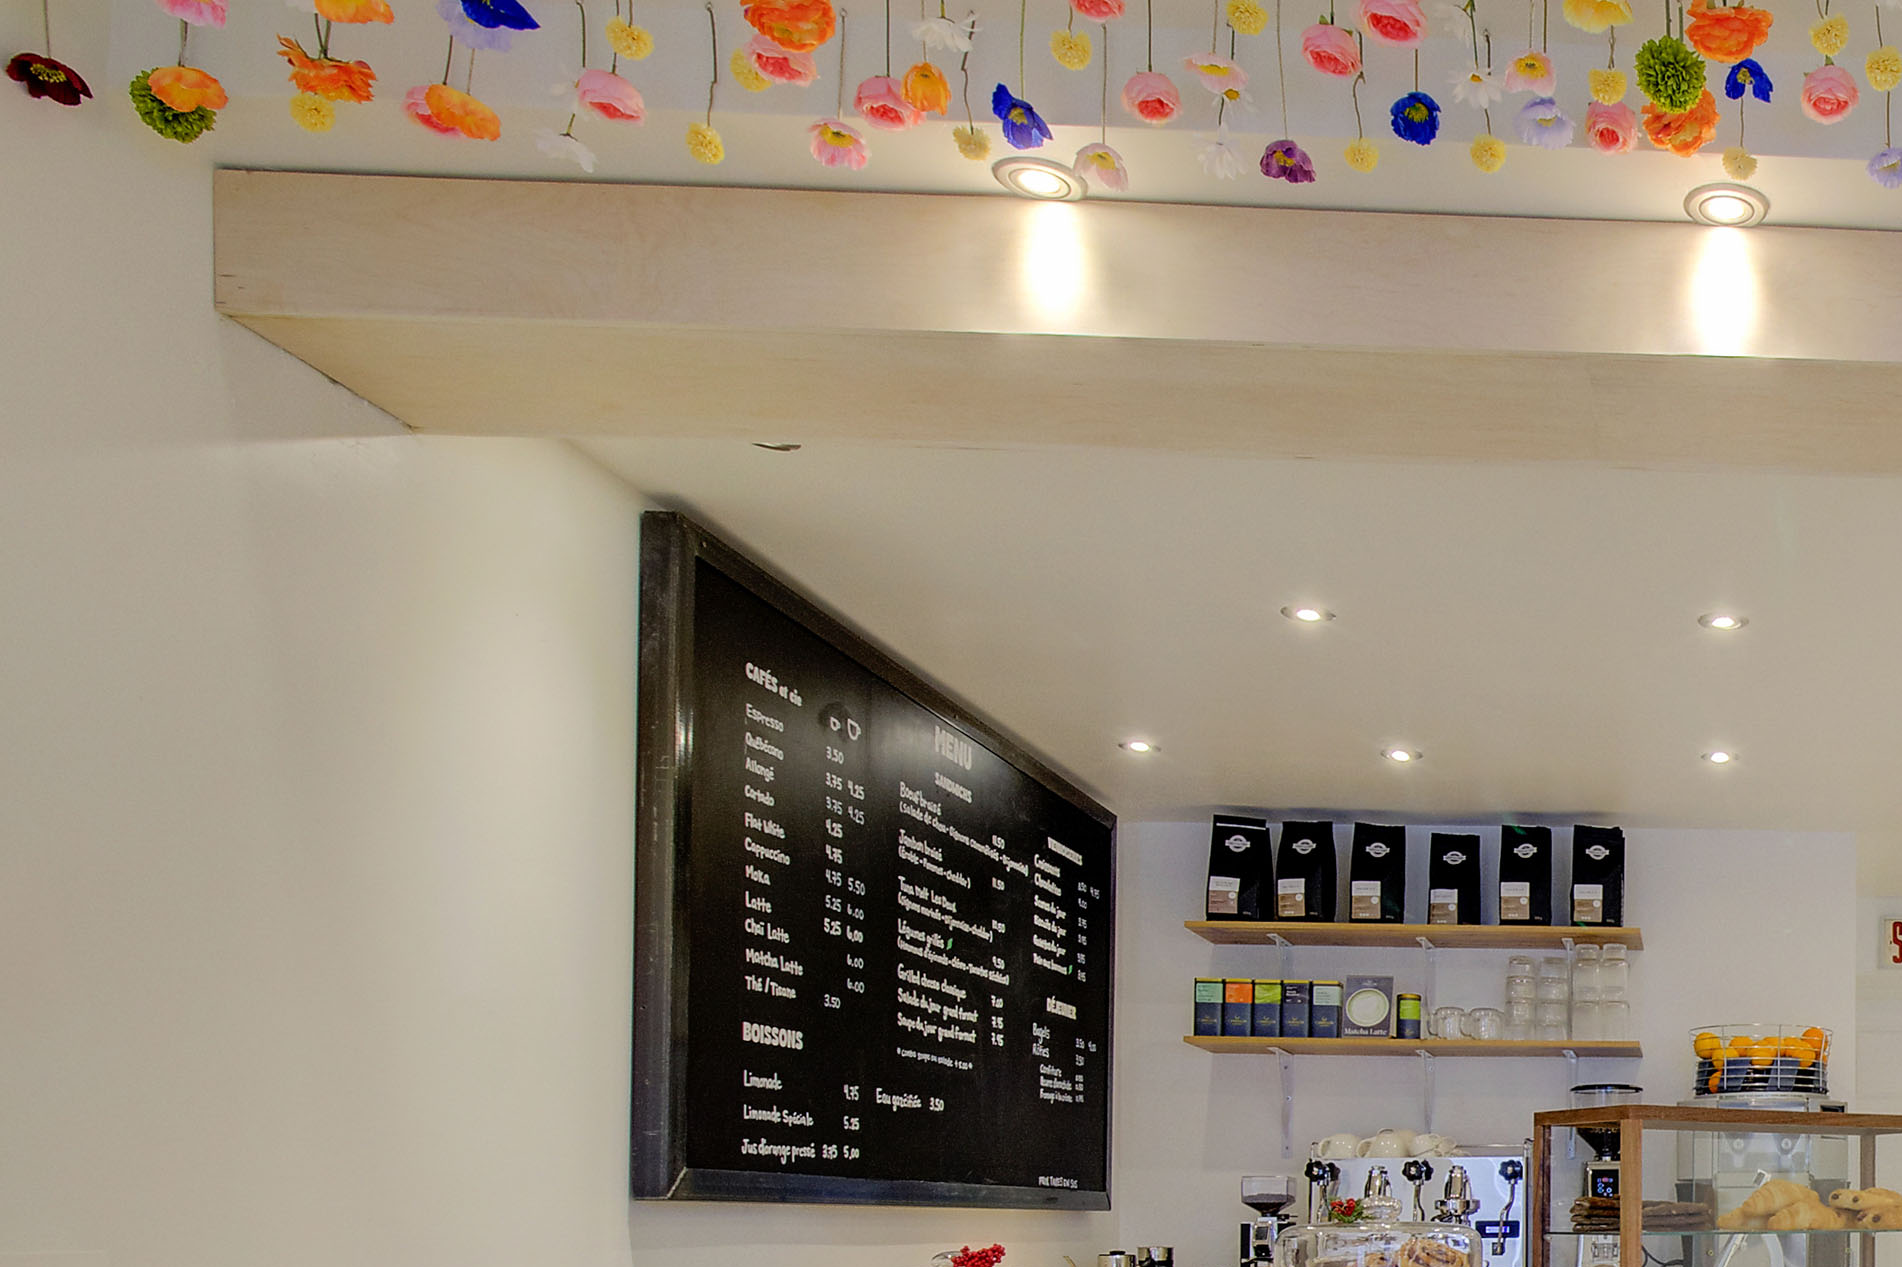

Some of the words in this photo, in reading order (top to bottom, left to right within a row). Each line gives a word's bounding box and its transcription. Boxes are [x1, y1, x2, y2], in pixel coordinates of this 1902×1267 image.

[934, 725, 972, 771] MENU
[745, 891, 772, 913] Latte
[767, 923, 790, 944] Latte
[745, 949, 779, 969] Matcha
[780, 956, 803, 976] Latte
[742, 1021, 803, 1050] BOISSONS
[741, 1139, 757, 1155] Jus
